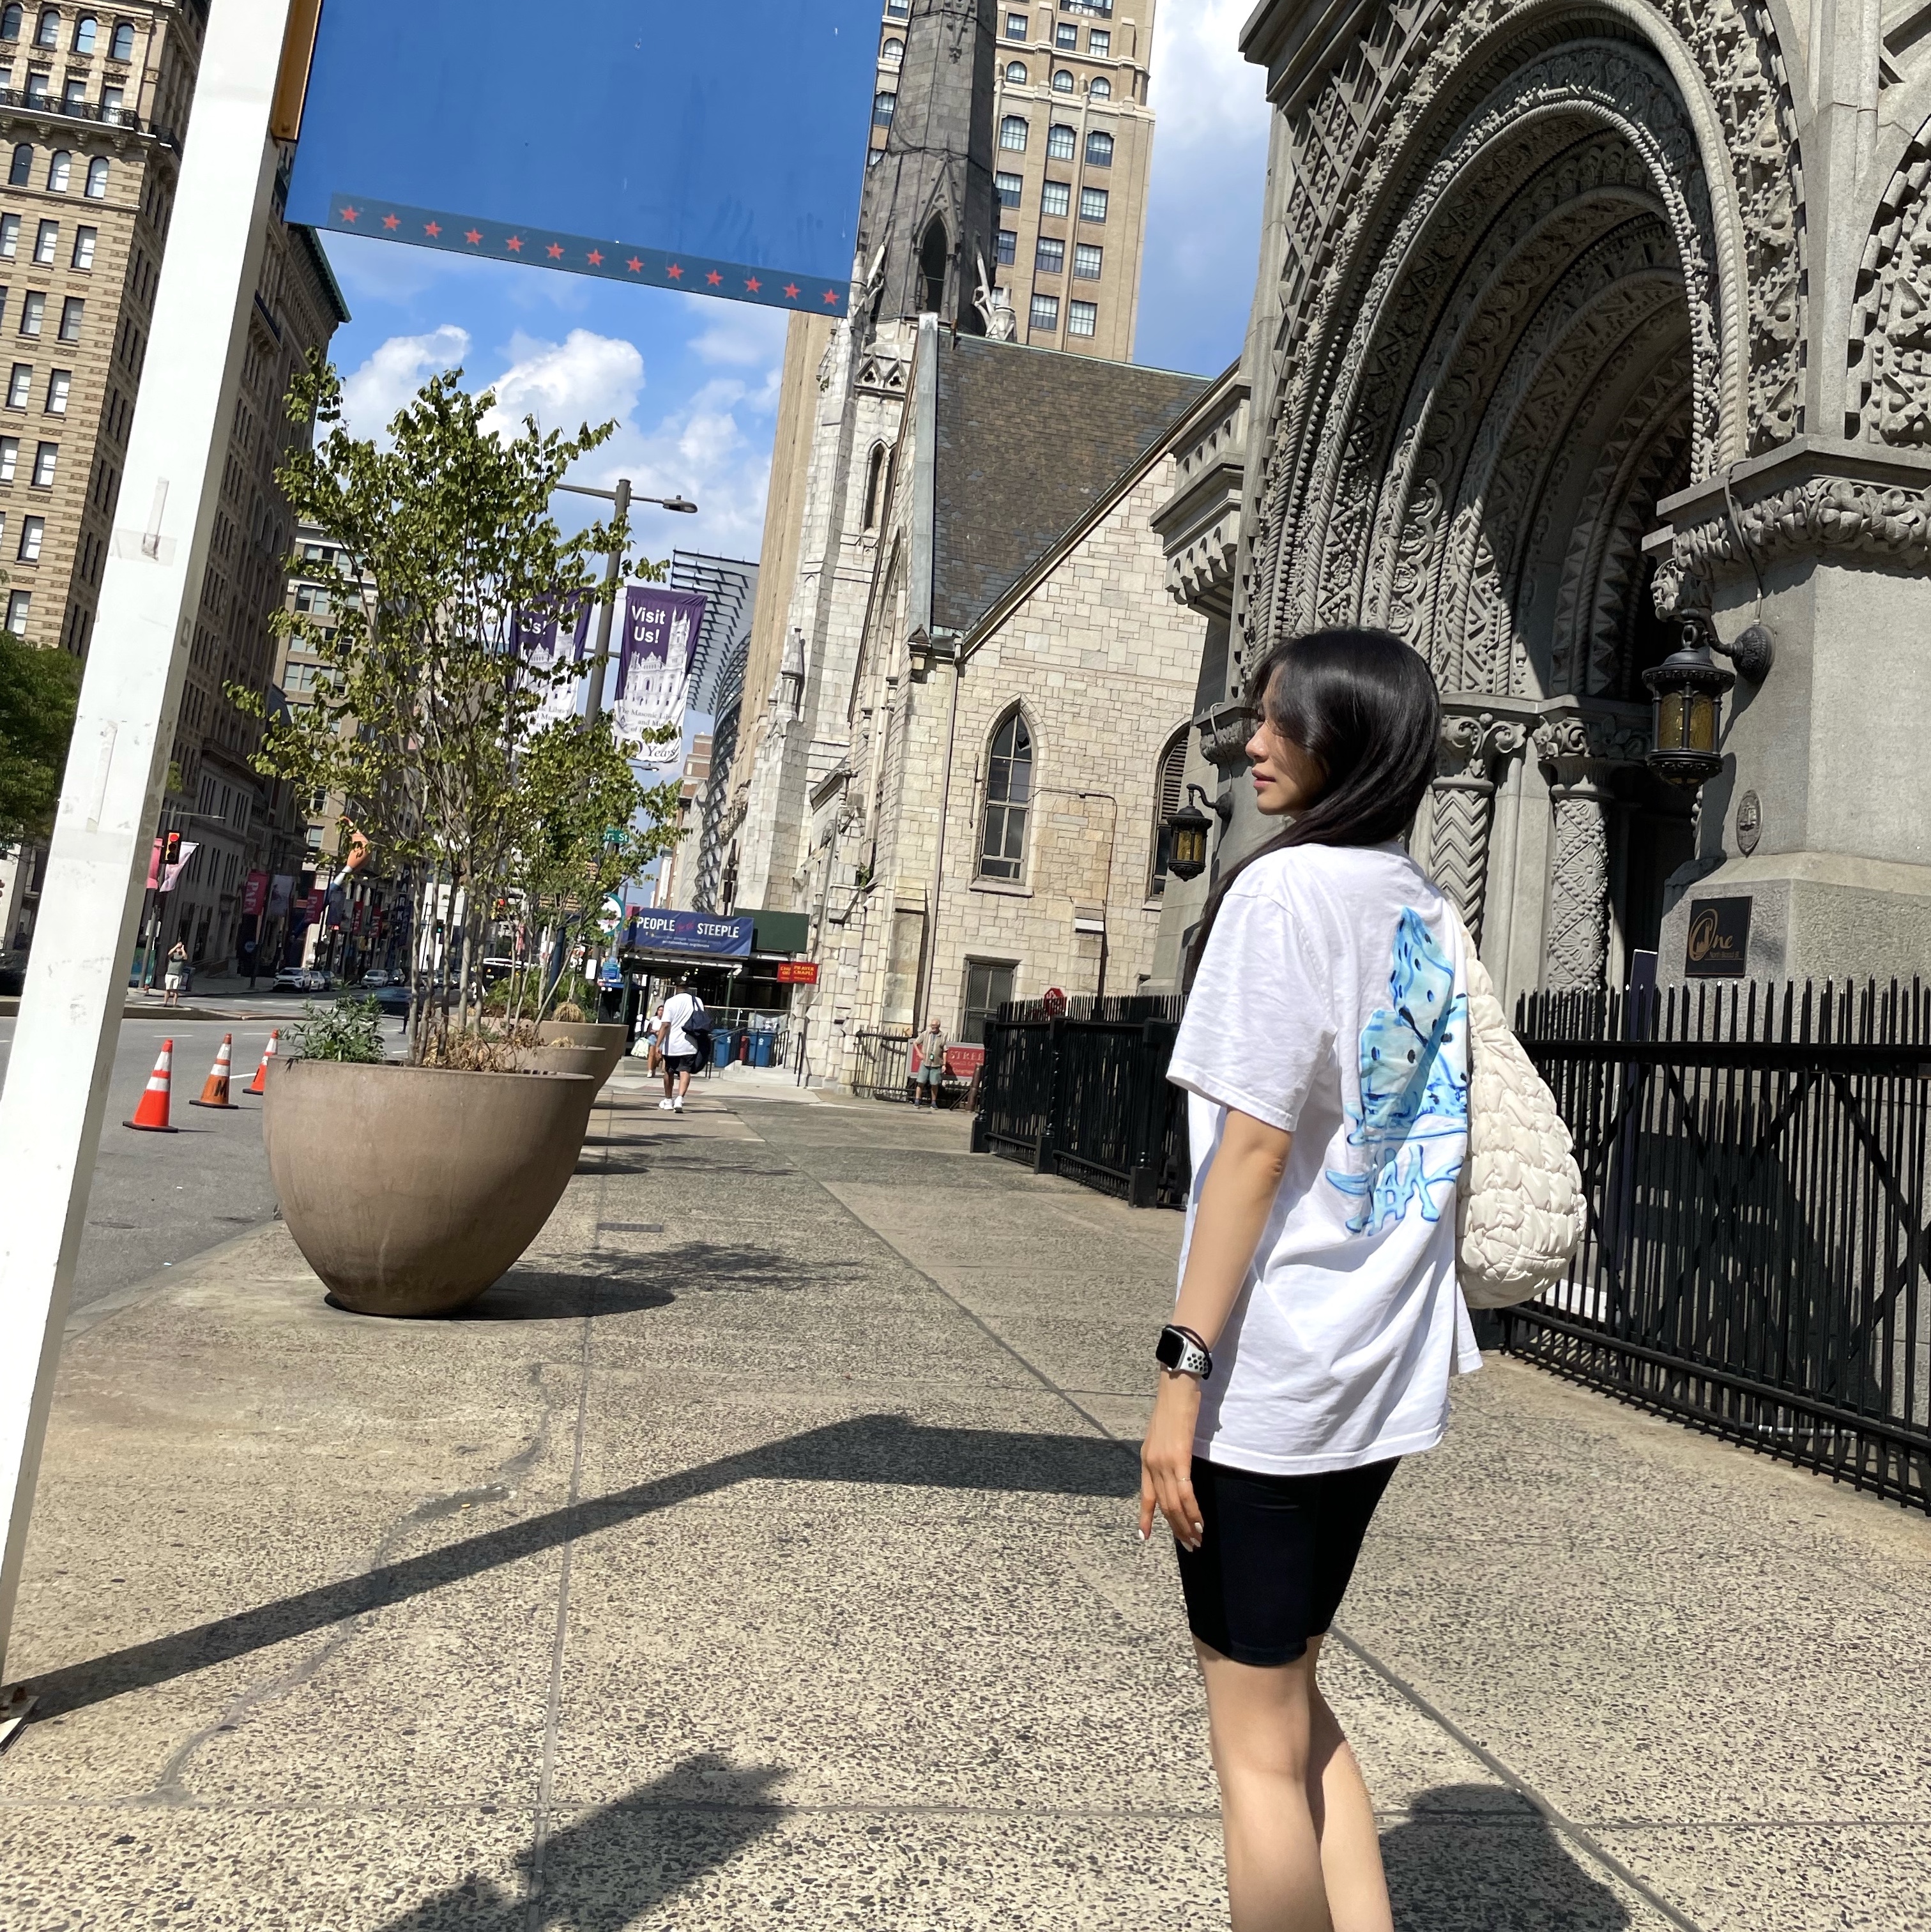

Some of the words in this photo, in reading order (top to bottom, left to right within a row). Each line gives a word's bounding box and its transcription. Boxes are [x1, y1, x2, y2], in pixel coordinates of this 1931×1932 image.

[632, 605, 666, 625] Visit
[634, 626, 660, 644] Us!
[631, 709, 657, 719] Masonic
[648, 745, 676, 757] Years
[619, 833, 628, 842] St
[636, 917, 675, 932] PEOPLE
[697, 922, 740, 938] STEEPLE
